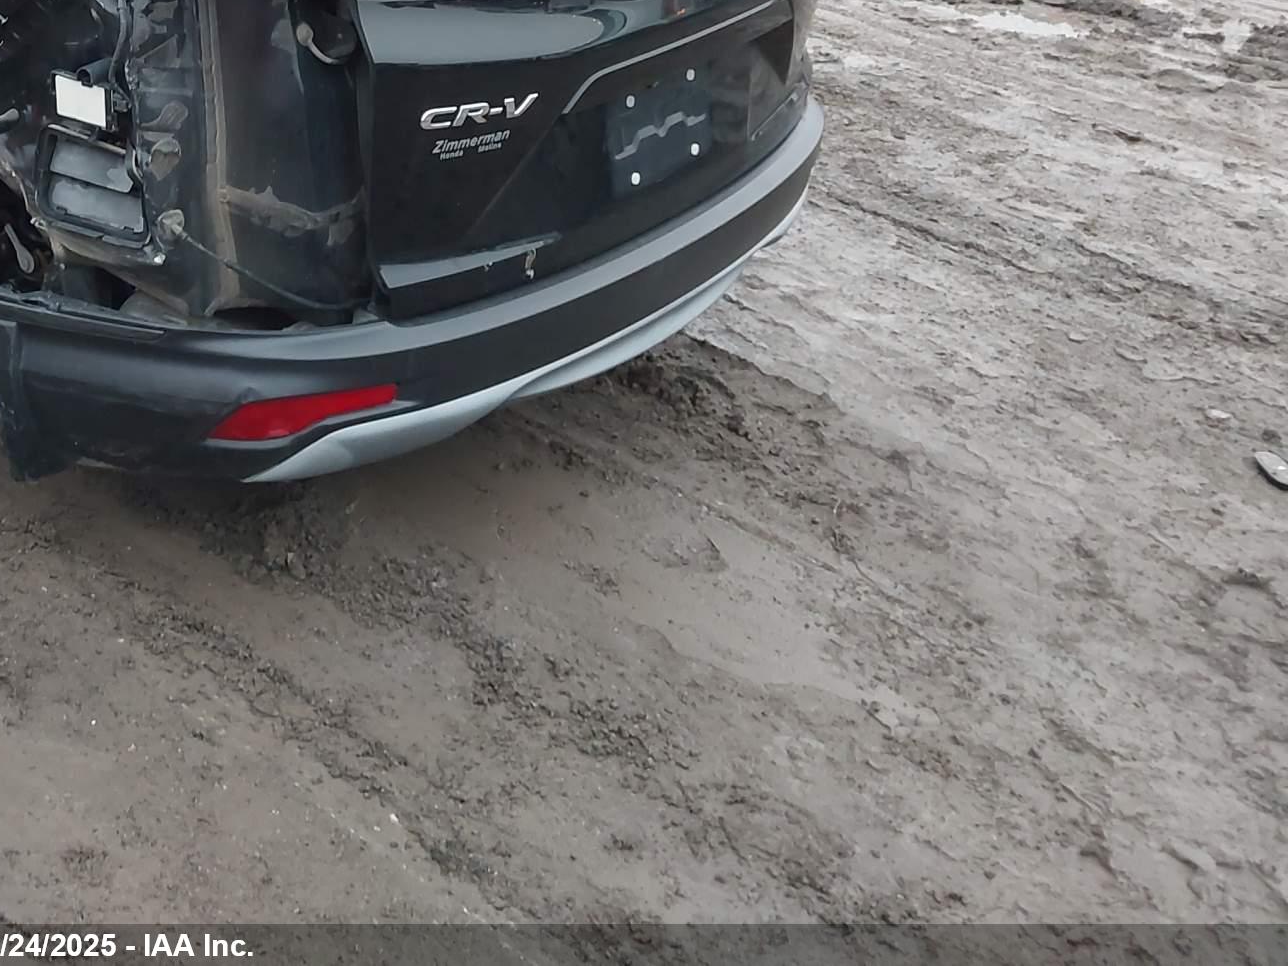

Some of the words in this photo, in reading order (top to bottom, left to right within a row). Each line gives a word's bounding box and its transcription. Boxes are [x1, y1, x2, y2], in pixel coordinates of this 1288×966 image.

[419, 92, 539, 130] CR-V
[432, 129, 511, 154] Zimmerman
[440, 150, 464, 161] Honda
